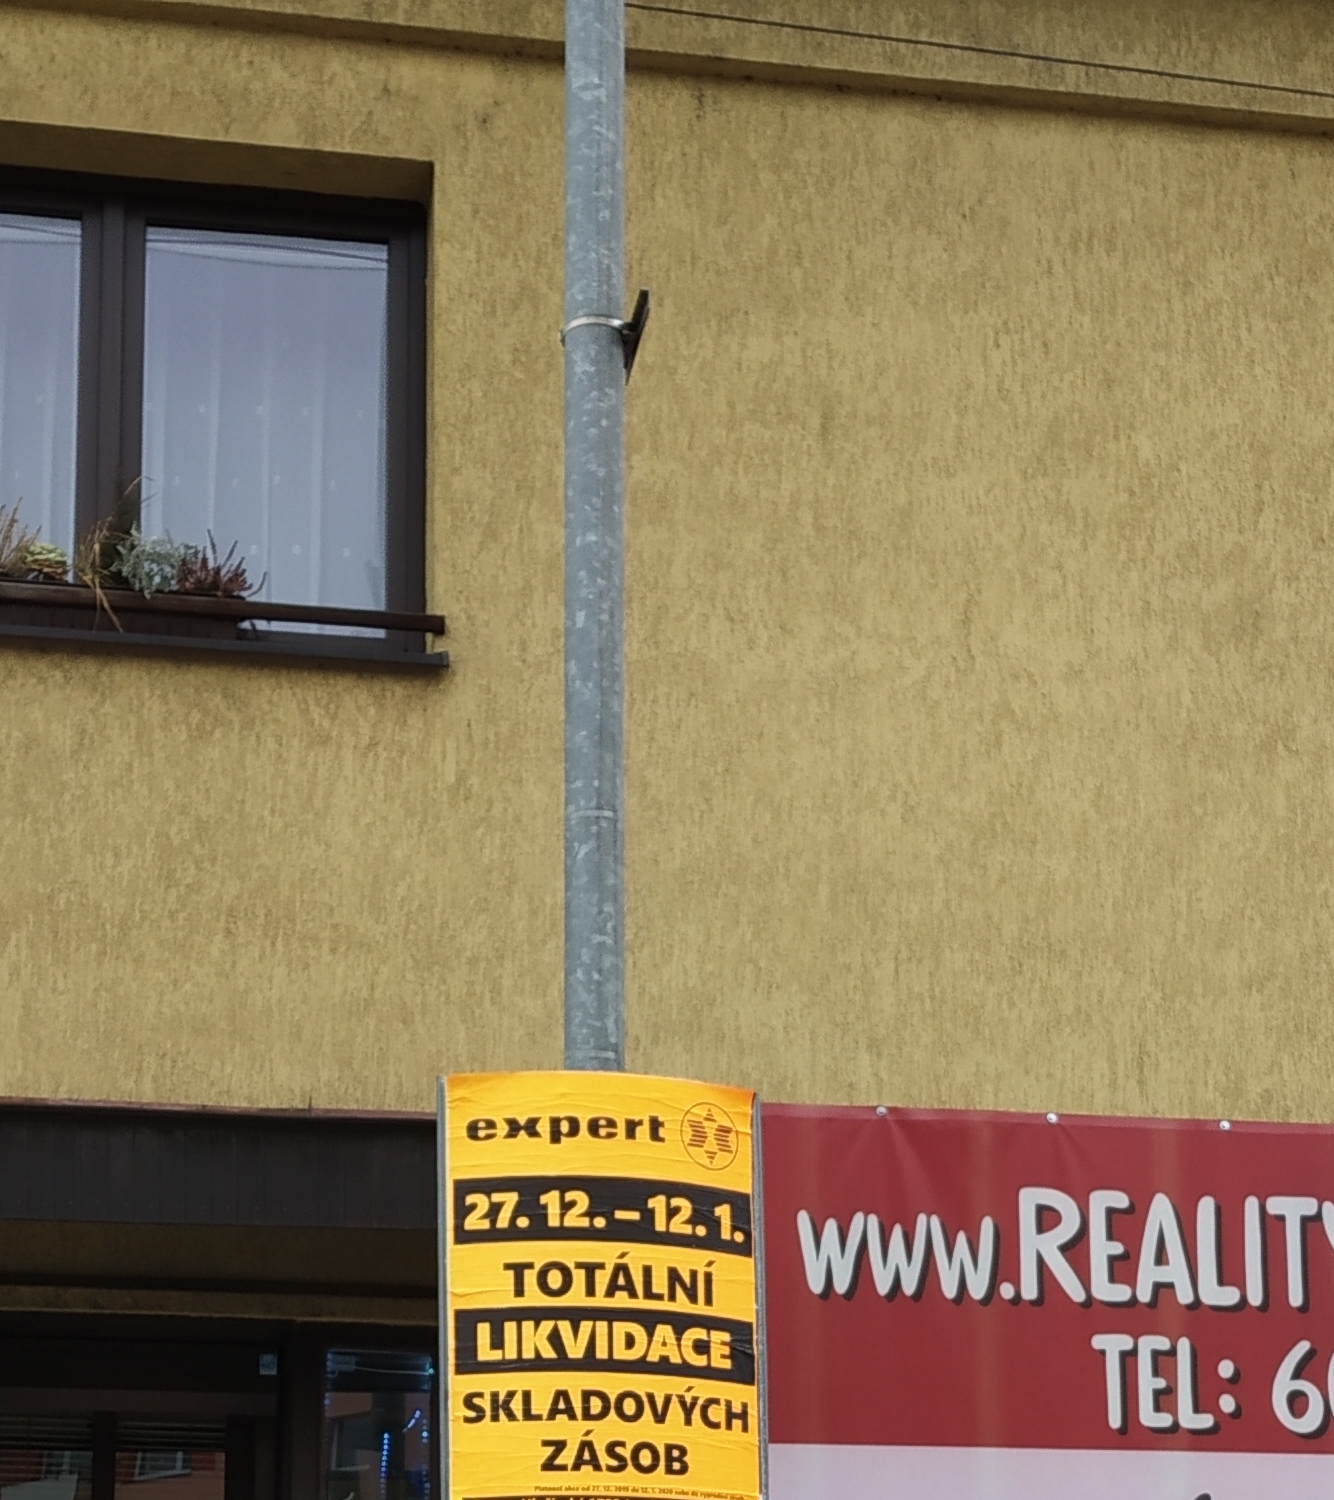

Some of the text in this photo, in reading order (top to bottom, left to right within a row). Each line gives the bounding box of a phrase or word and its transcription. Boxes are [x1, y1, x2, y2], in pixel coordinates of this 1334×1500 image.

[467, 1114, 665, 1145] expert
[464, 1192, 530, 1230] 27.
[503, 1252, 716, 1307] TOTÁLNÍ
[475, 1321, 732, 1370] LIKVIDACE
[1091, 1334, 1238, 1432] TEL:
[462, 1387, 750, 1433] SKLADOVÝCH
[540, 1430, 689, 1476] ZÁSOB
